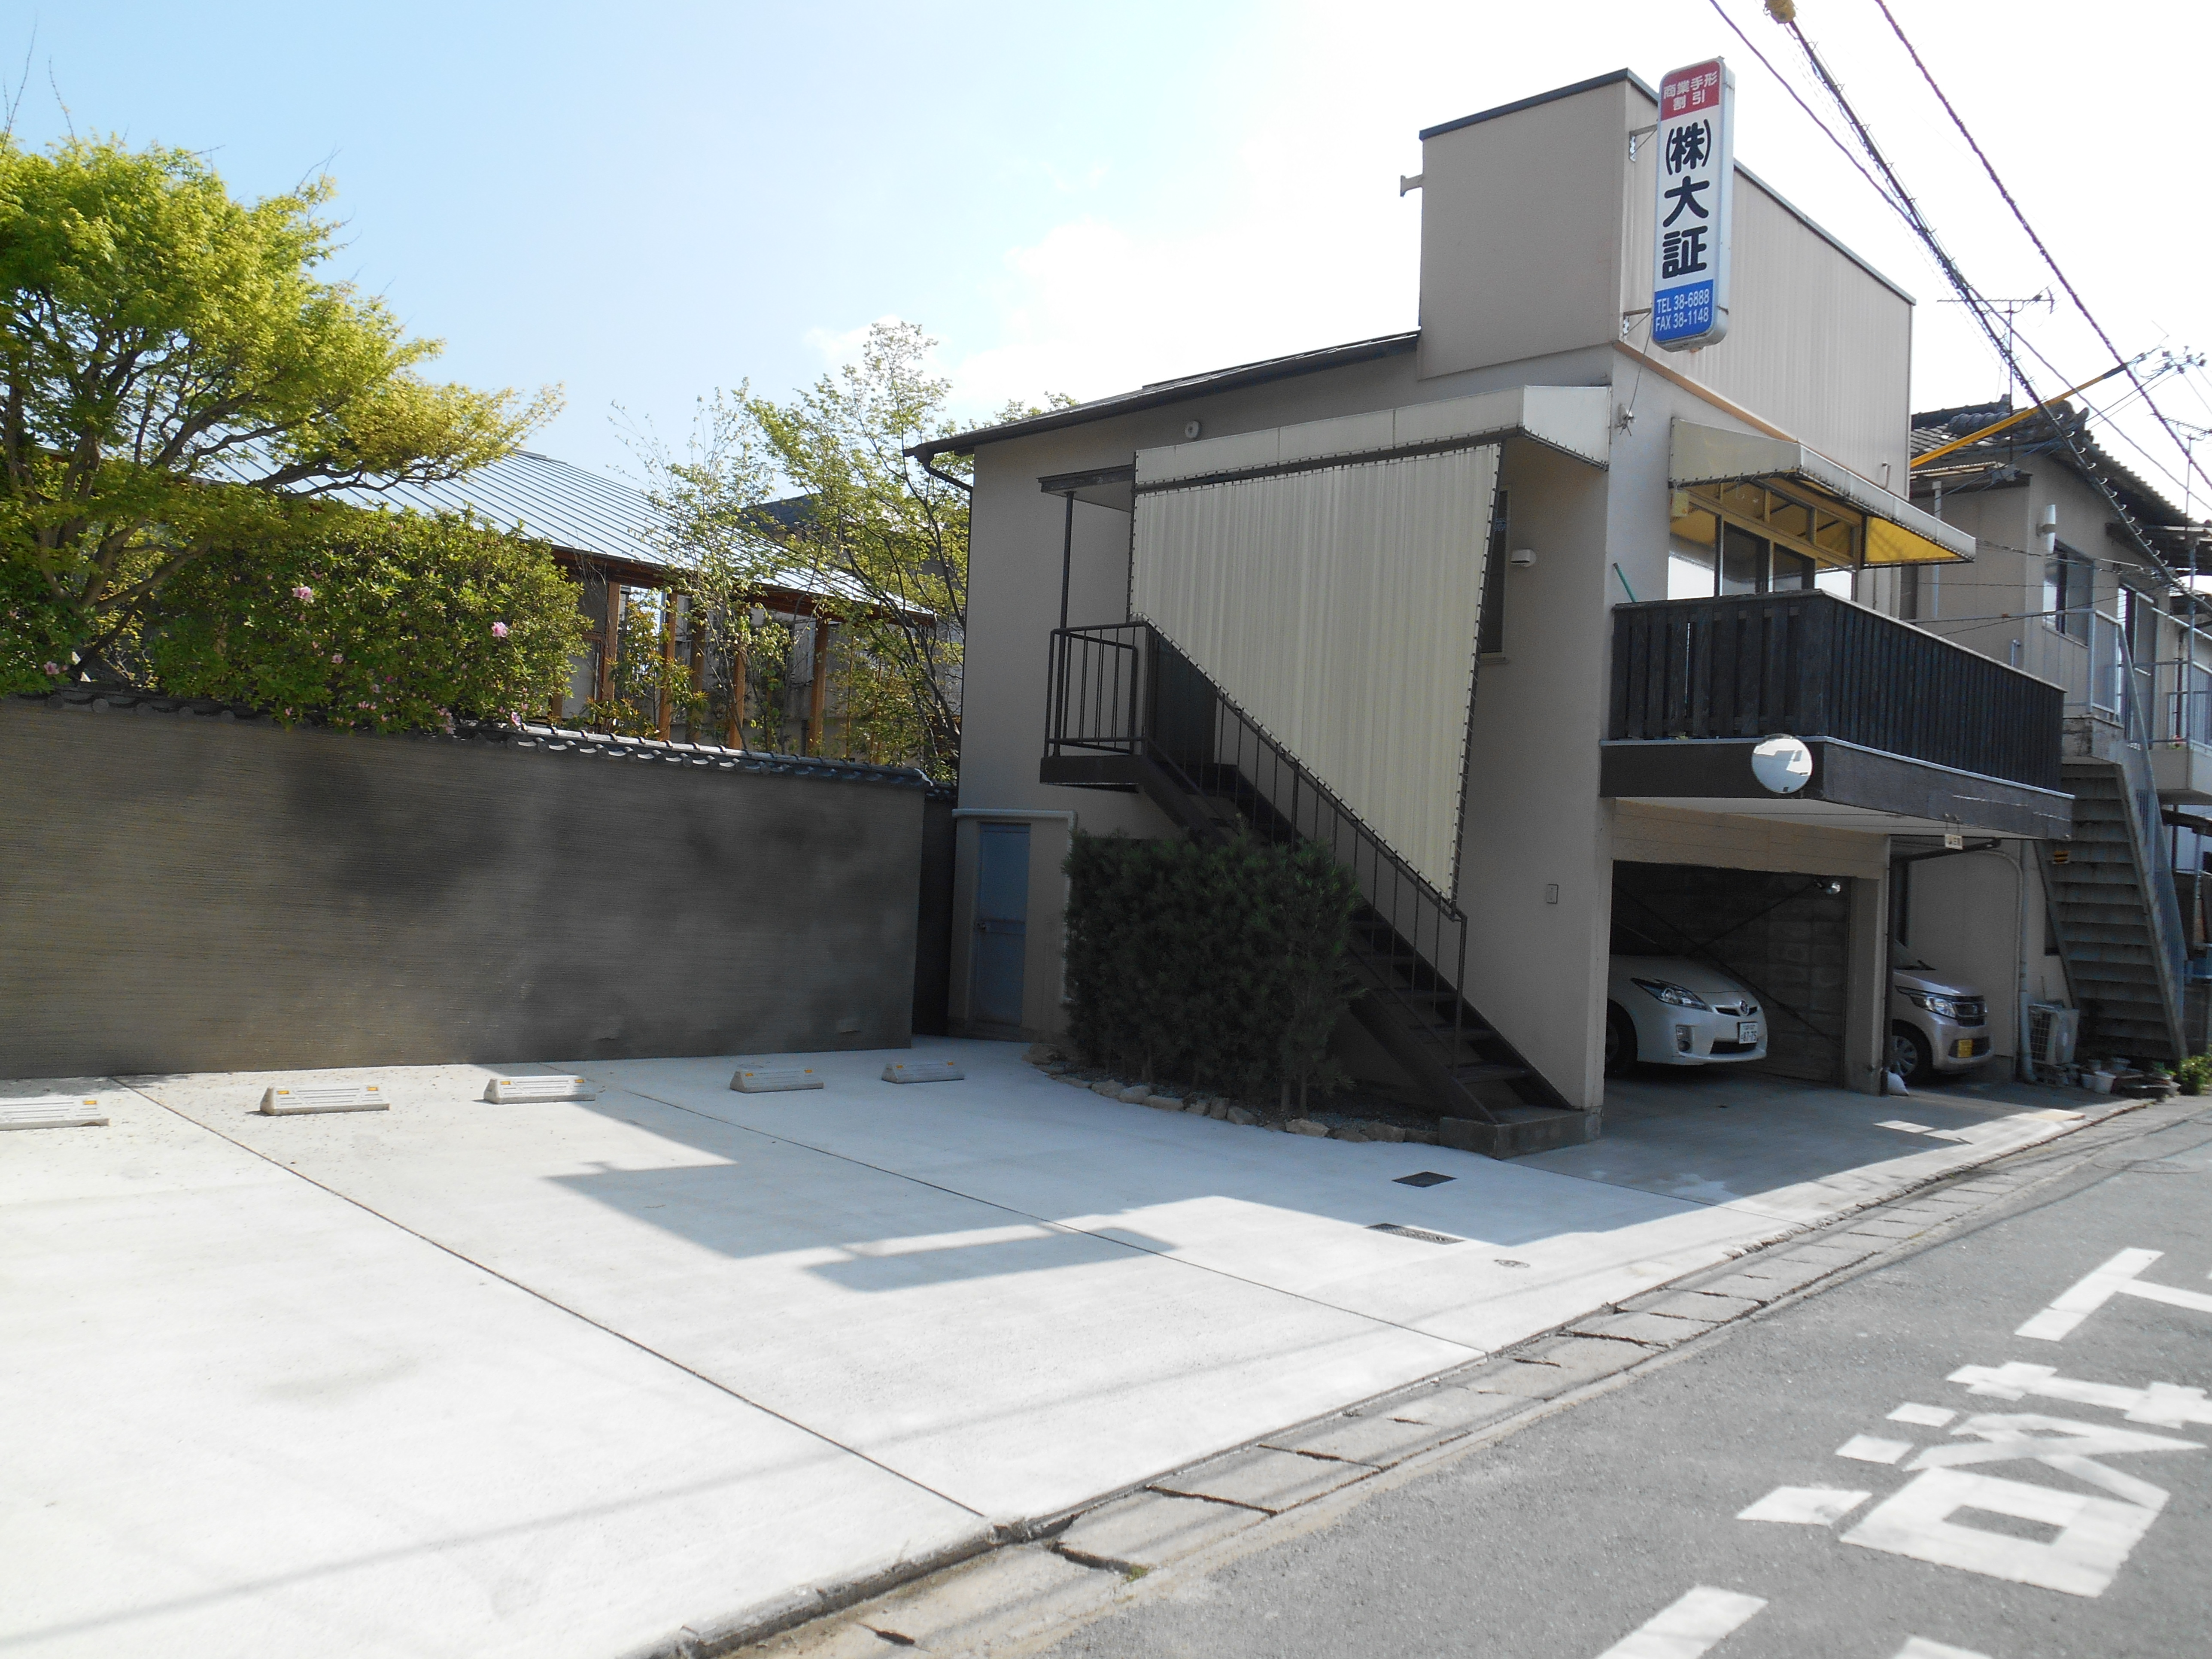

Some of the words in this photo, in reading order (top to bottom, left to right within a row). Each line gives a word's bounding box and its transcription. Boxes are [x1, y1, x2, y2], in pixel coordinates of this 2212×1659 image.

[1664, 70, 1718, 99] 商業手形
[1673, 89, 1705, 110] 割引
[1657, 298, 1671, 313] TEL
[1674, 289, 1709, 310] 38-6888
[1656, 314, 1671, 331] FAX
[1673, 307, 1709, 328] 38-1148
